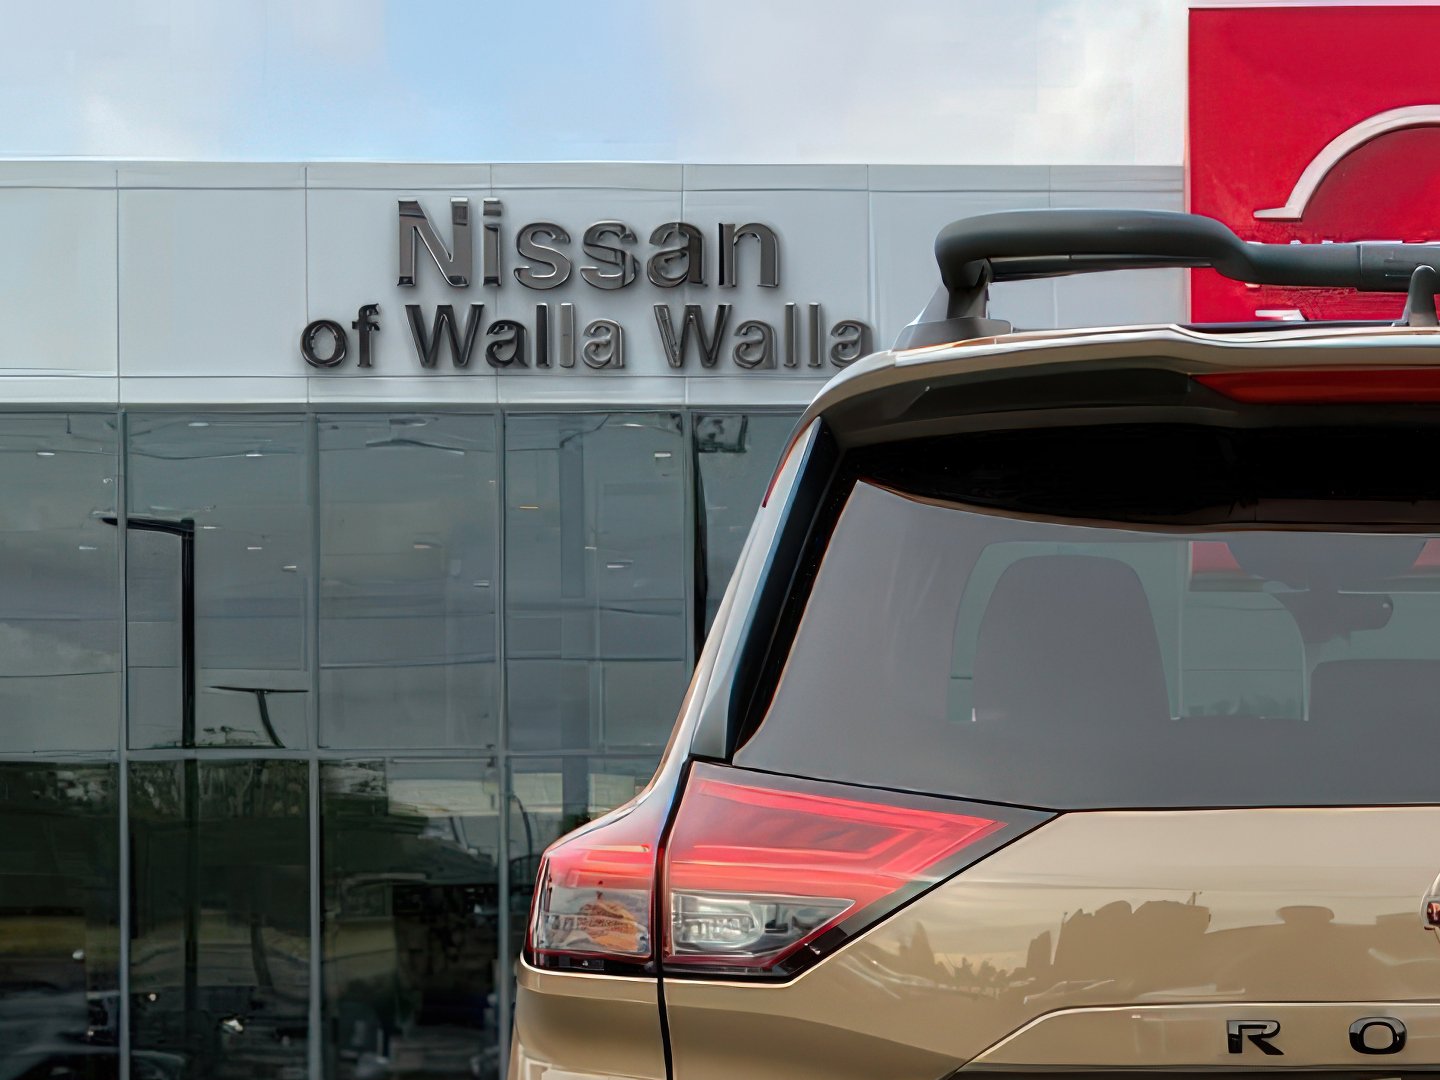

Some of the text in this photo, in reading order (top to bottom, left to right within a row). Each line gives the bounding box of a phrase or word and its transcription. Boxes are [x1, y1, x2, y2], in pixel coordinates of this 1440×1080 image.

[397, 197, 781, 290] Nissan
[299, 302, 874, 370] of Walla Walla
